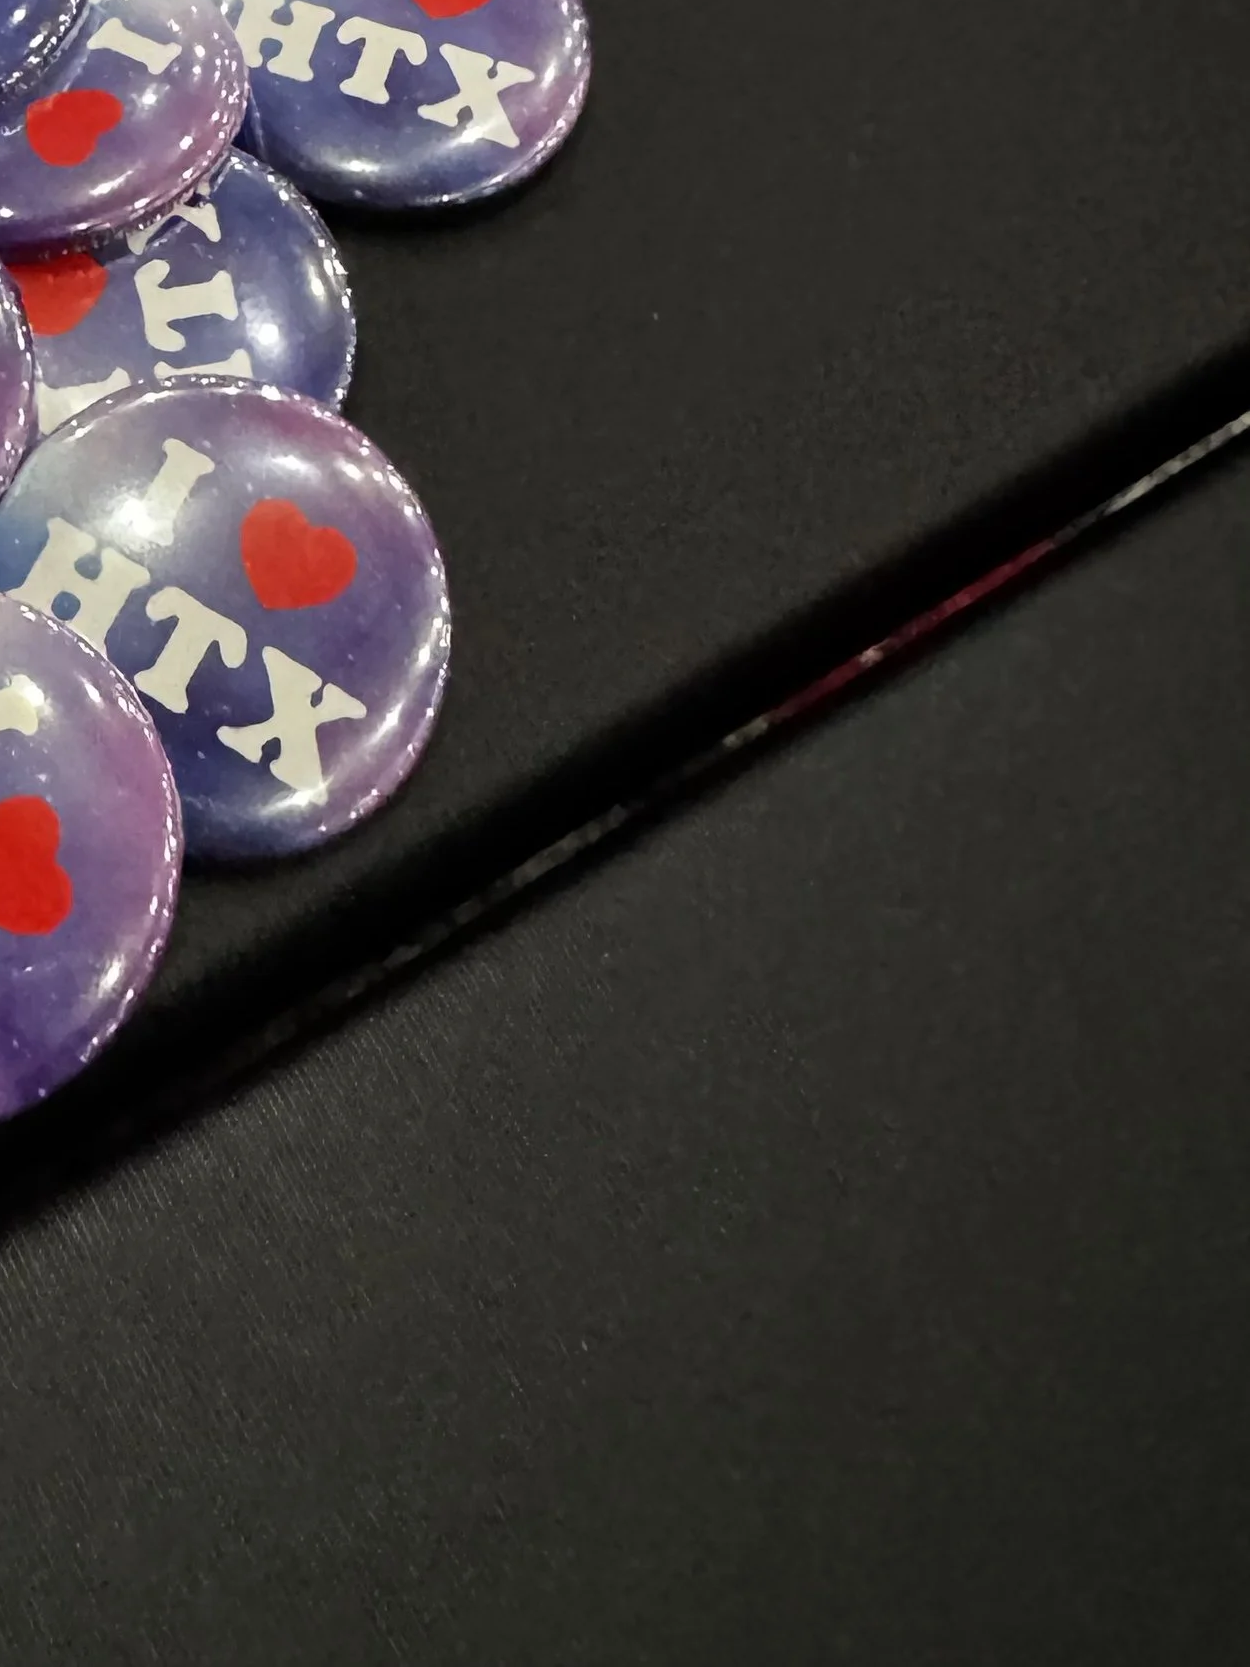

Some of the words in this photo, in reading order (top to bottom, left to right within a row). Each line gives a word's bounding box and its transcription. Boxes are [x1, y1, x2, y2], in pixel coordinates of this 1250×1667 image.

[87, 17, 183, 75] I
[142, 438, 216, 546] I
[4, 517, 367, 806] HTX
